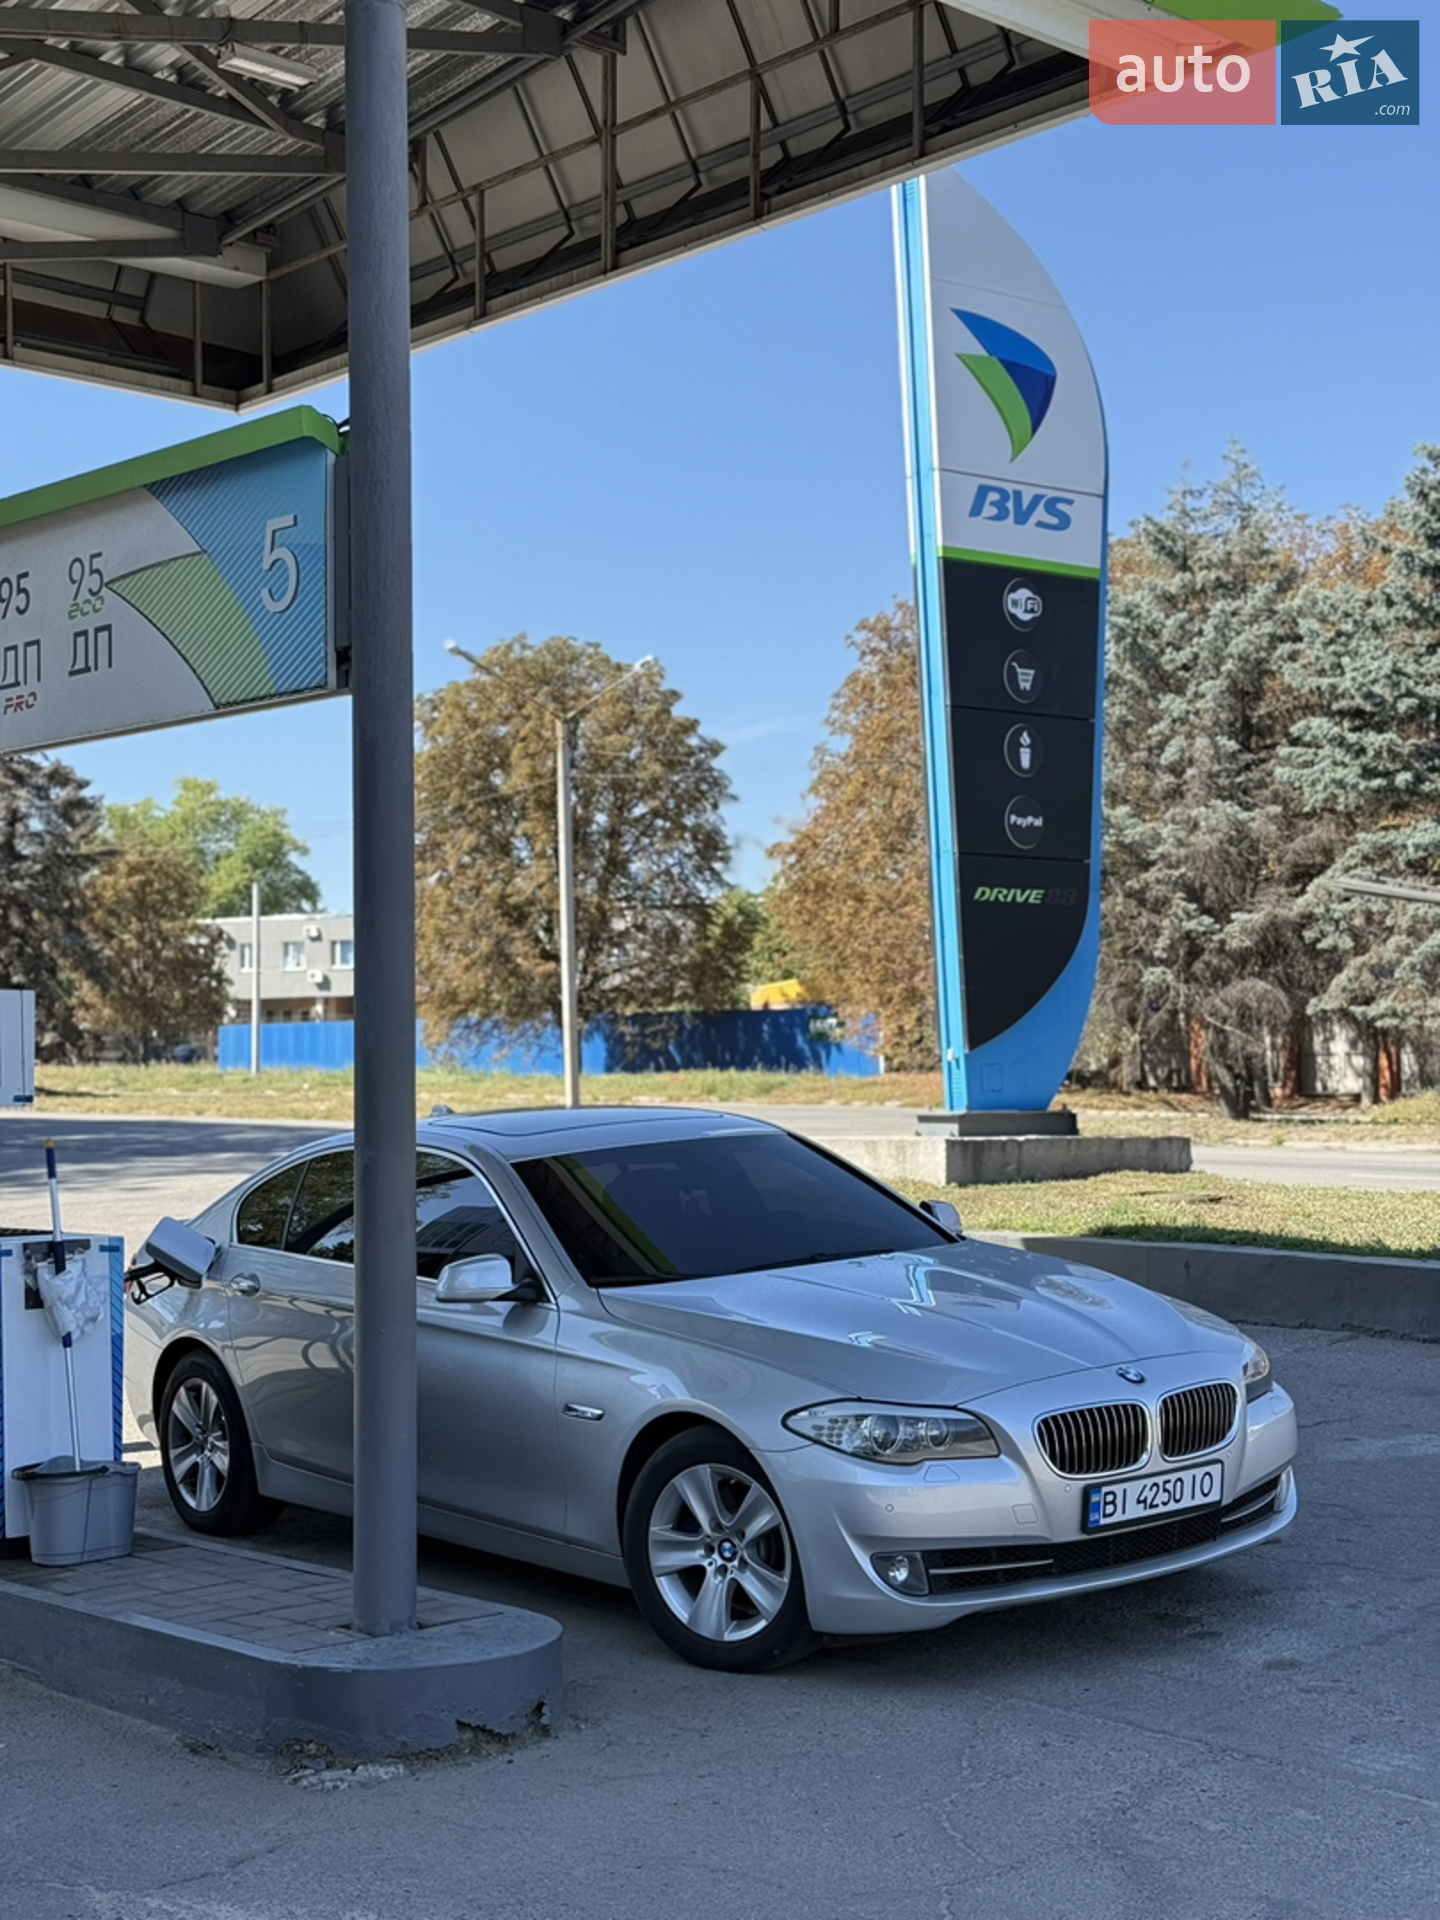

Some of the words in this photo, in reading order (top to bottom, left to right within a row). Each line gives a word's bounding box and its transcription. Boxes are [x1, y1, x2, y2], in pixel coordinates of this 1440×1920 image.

[968, 484, 1075, 531] BVS
[0, 571, 31, 620] 95
[68, 551, 103, 601] 95
[260, 514, 298, 613] 5
[0, 638, 41, 690] ДП
[68, 623, 113, 677] ДП
[3, 691, 38, 715] PRO
[1010, 814, 1043, 827] PayPal
[1102, 1488, 1127, 1518] BI
[1136, 1477, 1184, 1511] 4250
